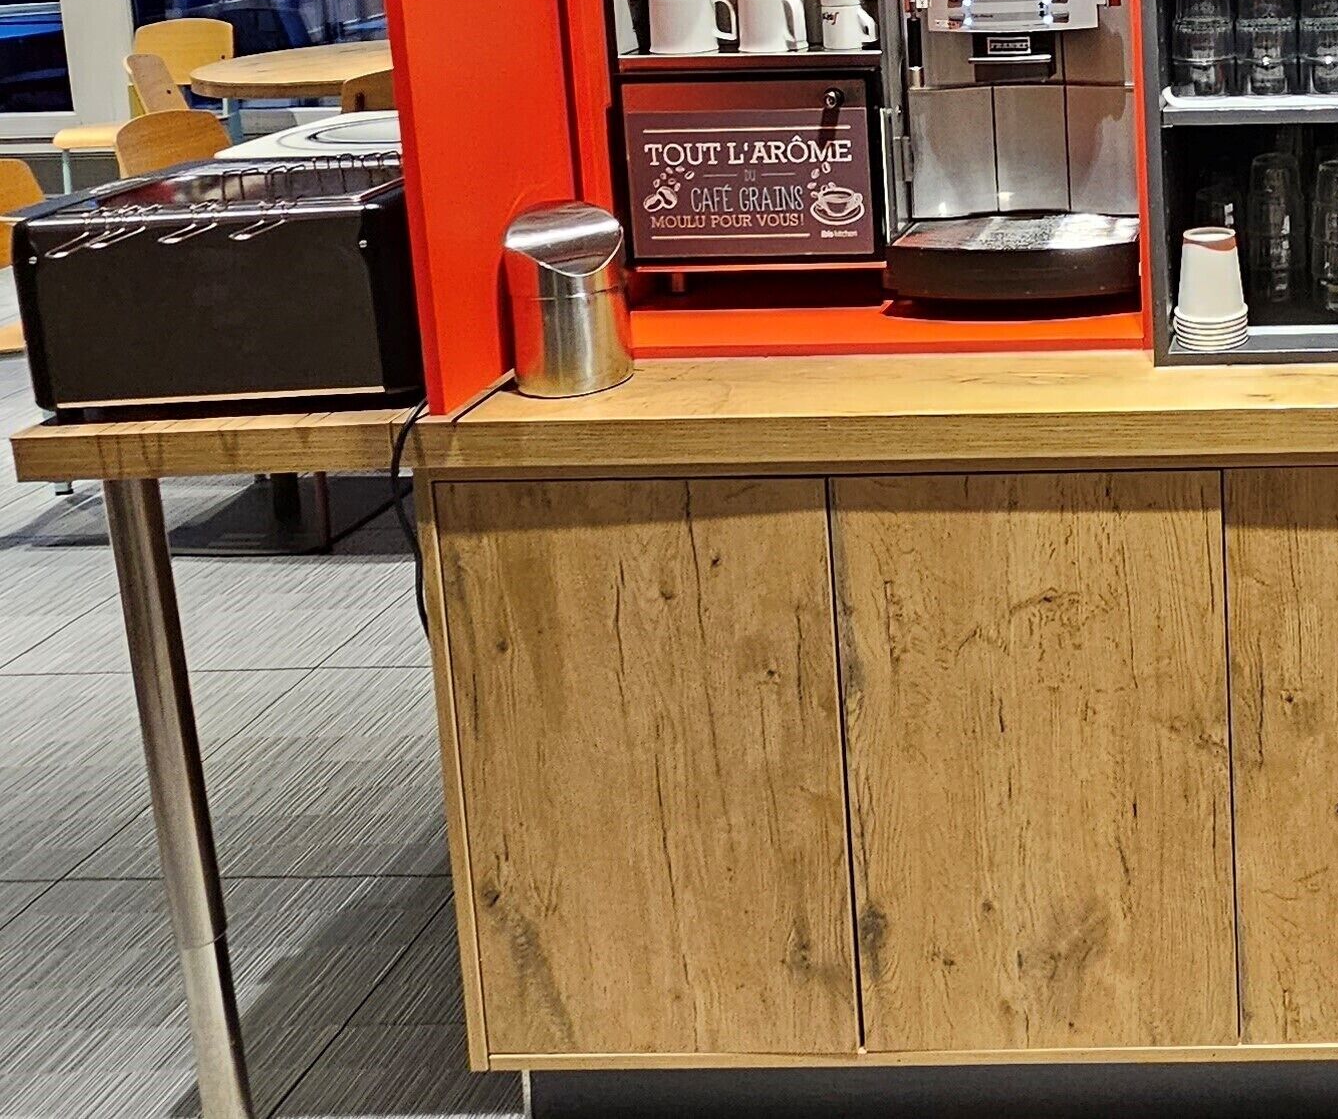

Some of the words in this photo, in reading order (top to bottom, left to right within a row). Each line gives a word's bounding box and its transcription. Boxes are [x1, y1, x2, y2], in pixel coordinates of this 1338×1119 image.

[644, 142, 721, 167] TOUT
[728, 135, 853, 166] L'ARÔME
[744, 170, 756, 181] DU
[690, 184, 734, 213] CAFÉ
[739, 184, 804, 212] GRAINS
[651, 213, 706, 229] MOULU
[711, 213, 752, 228] POUR
[755, 213, 805, 227] VOUS!
